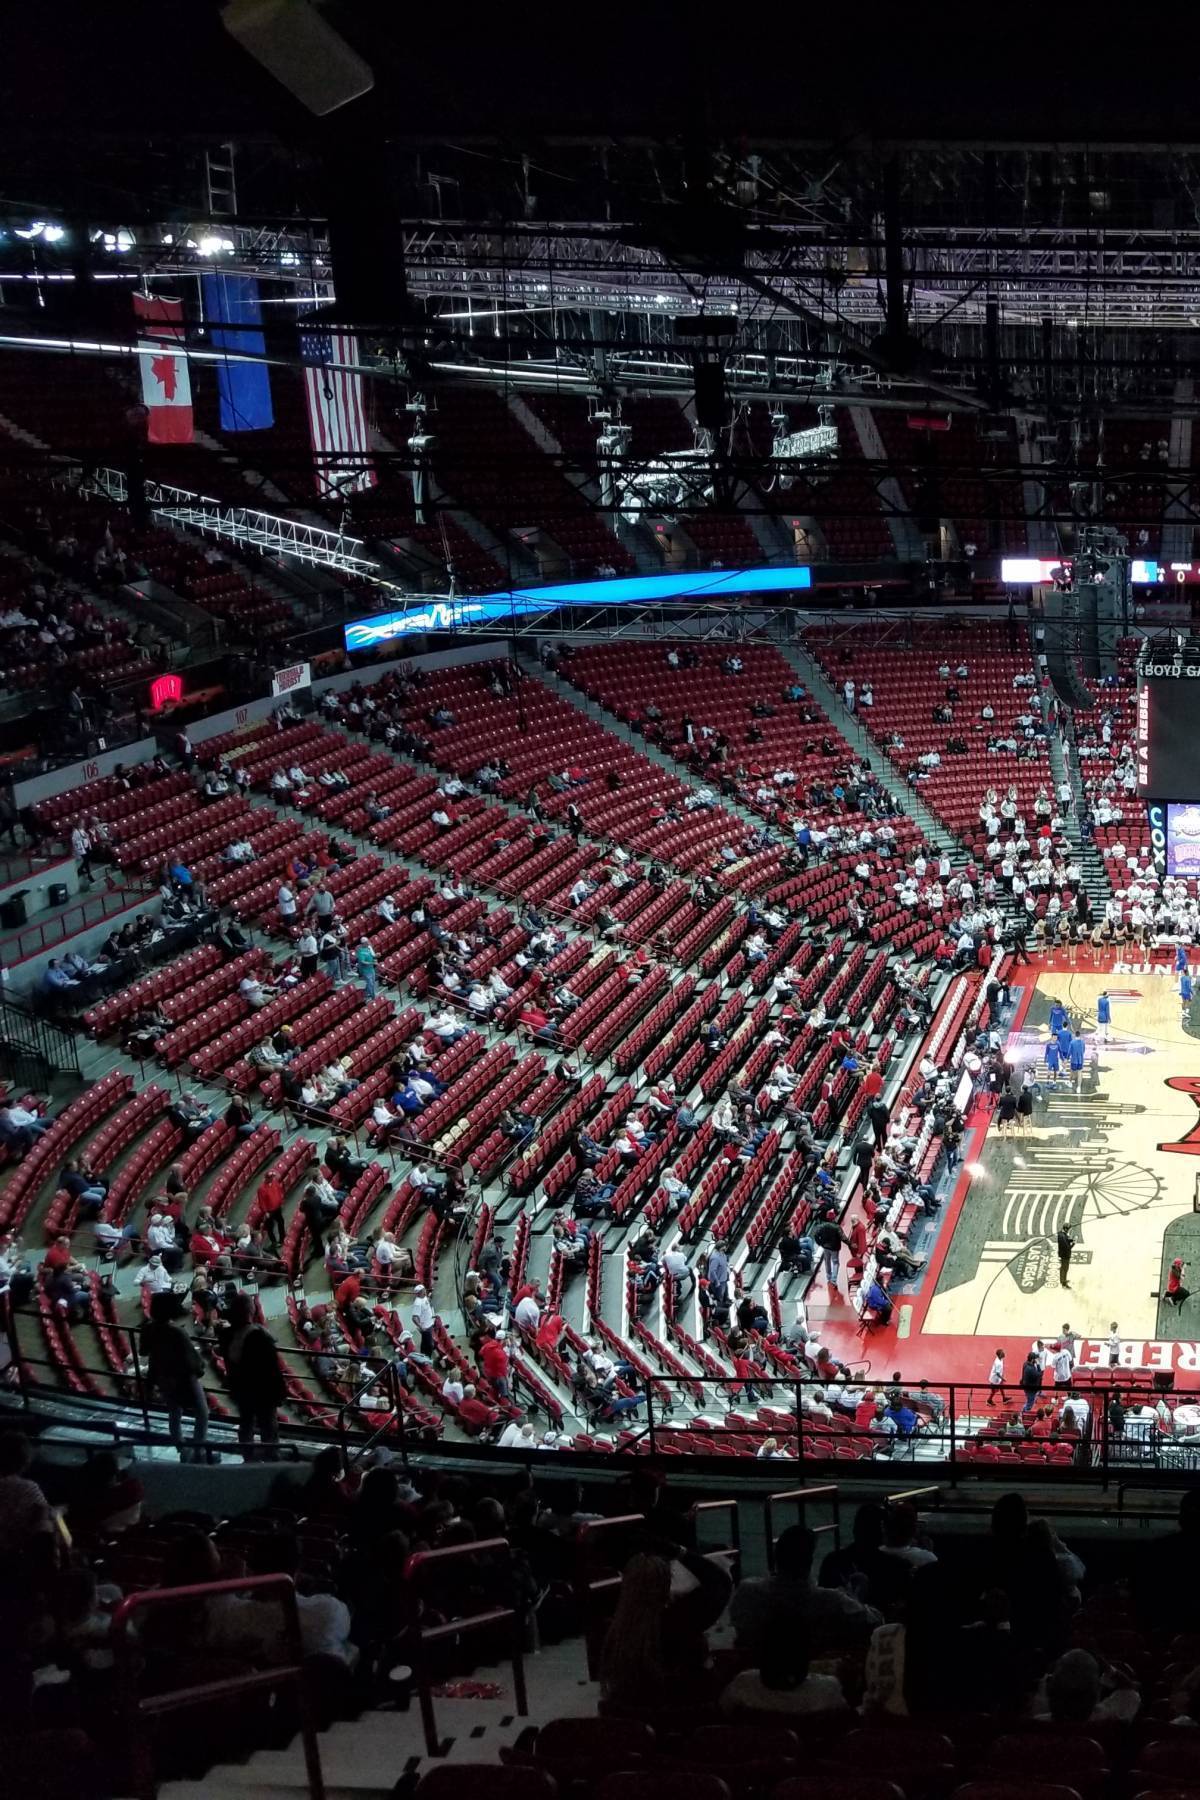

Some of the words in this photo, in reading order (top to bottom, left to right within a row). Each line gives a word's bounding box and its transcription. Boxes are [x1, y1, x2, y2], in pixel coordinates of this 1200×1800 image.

[1177, 571, 1185, 583] 0
[1144, 664, 1181, 678] BOYD
[234, 708, 248, 724] 107
[1139, 746, 1149, 760] A
[82, 762, 99, 781] 106
[1139, 764, 1148, 785] BE
[1150, 806, 1165, 866] COX
[1027, 1245, 1042, 1261] LAS
[1021, 1261, 1038, 1288] VEGAS
